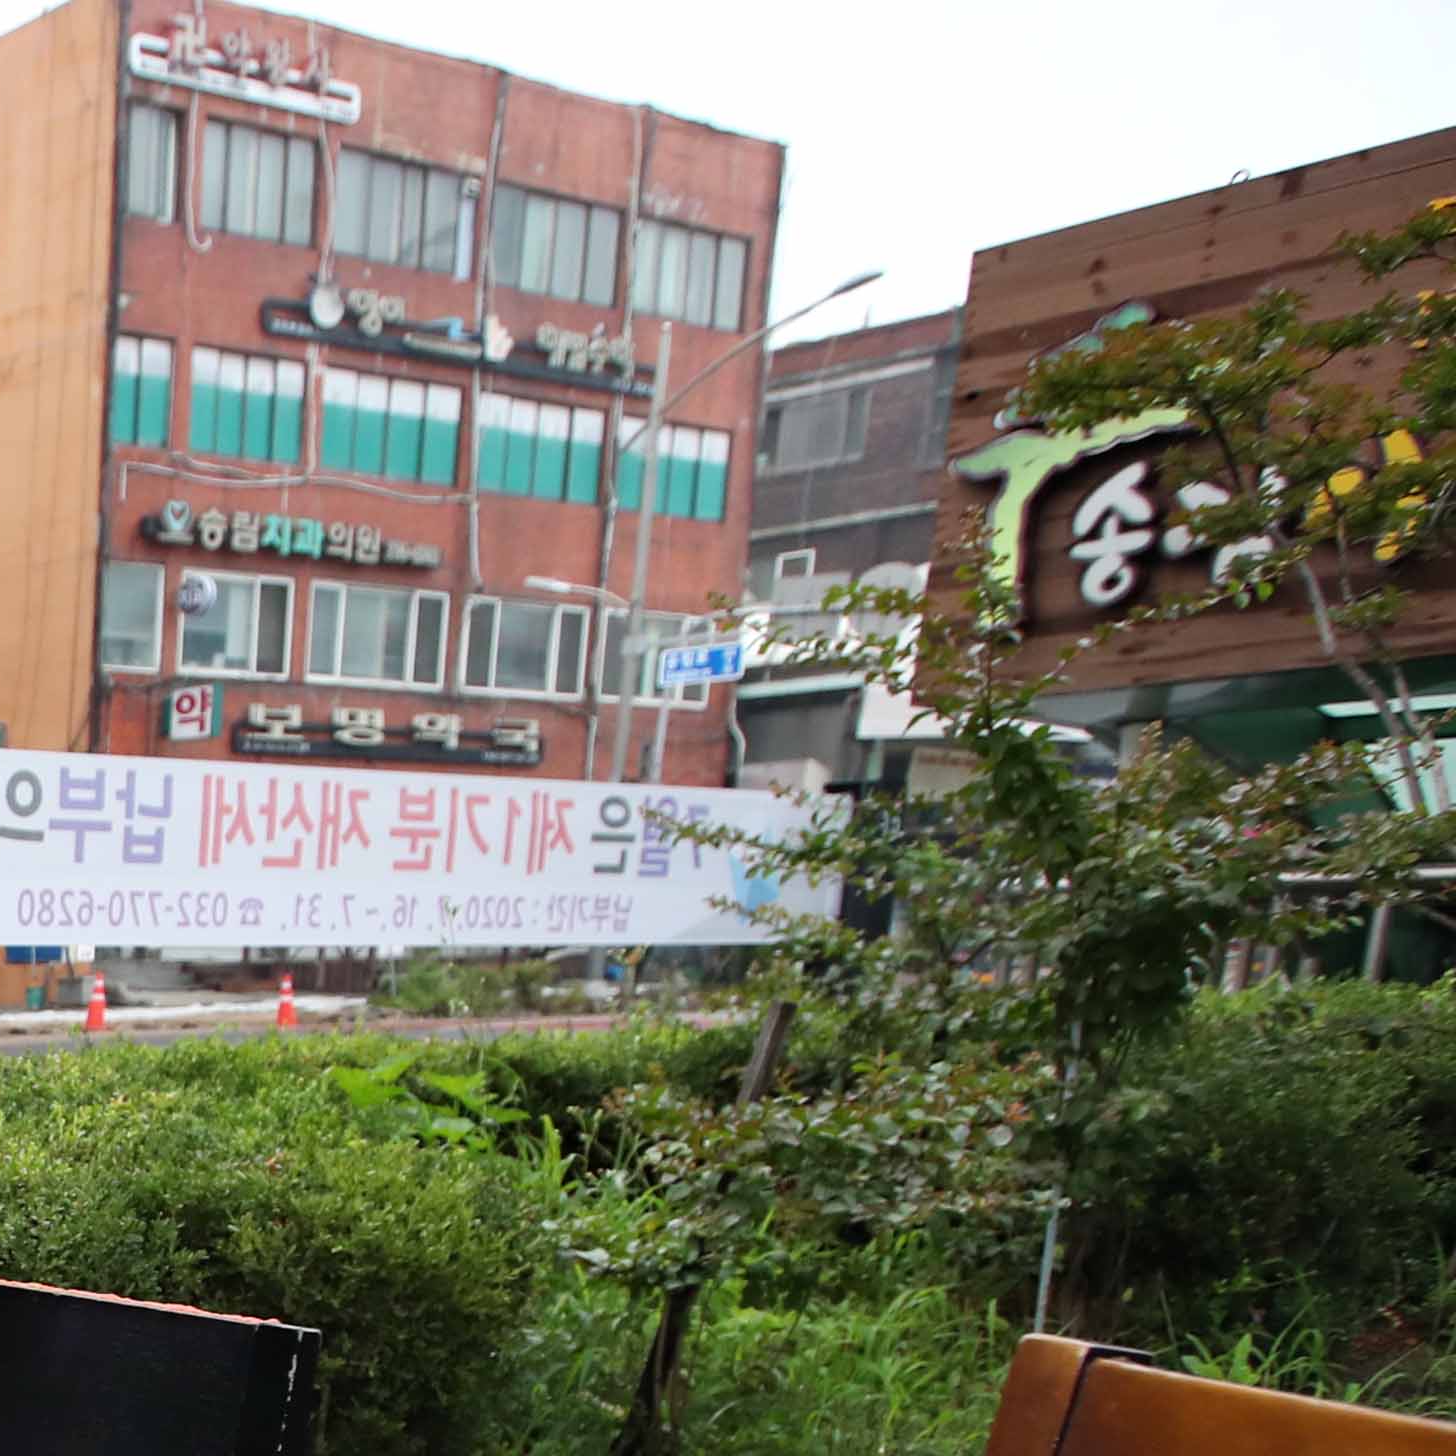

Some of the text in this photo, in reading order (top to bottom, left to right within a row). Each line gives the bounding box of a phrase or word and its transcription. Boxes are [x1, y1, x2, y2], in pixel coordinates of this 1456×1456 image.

[199, 507, 381, 564] 송림치과의원
[175, 685, 210, 733] 약
[247, 703, 541, 756] 보명약국
